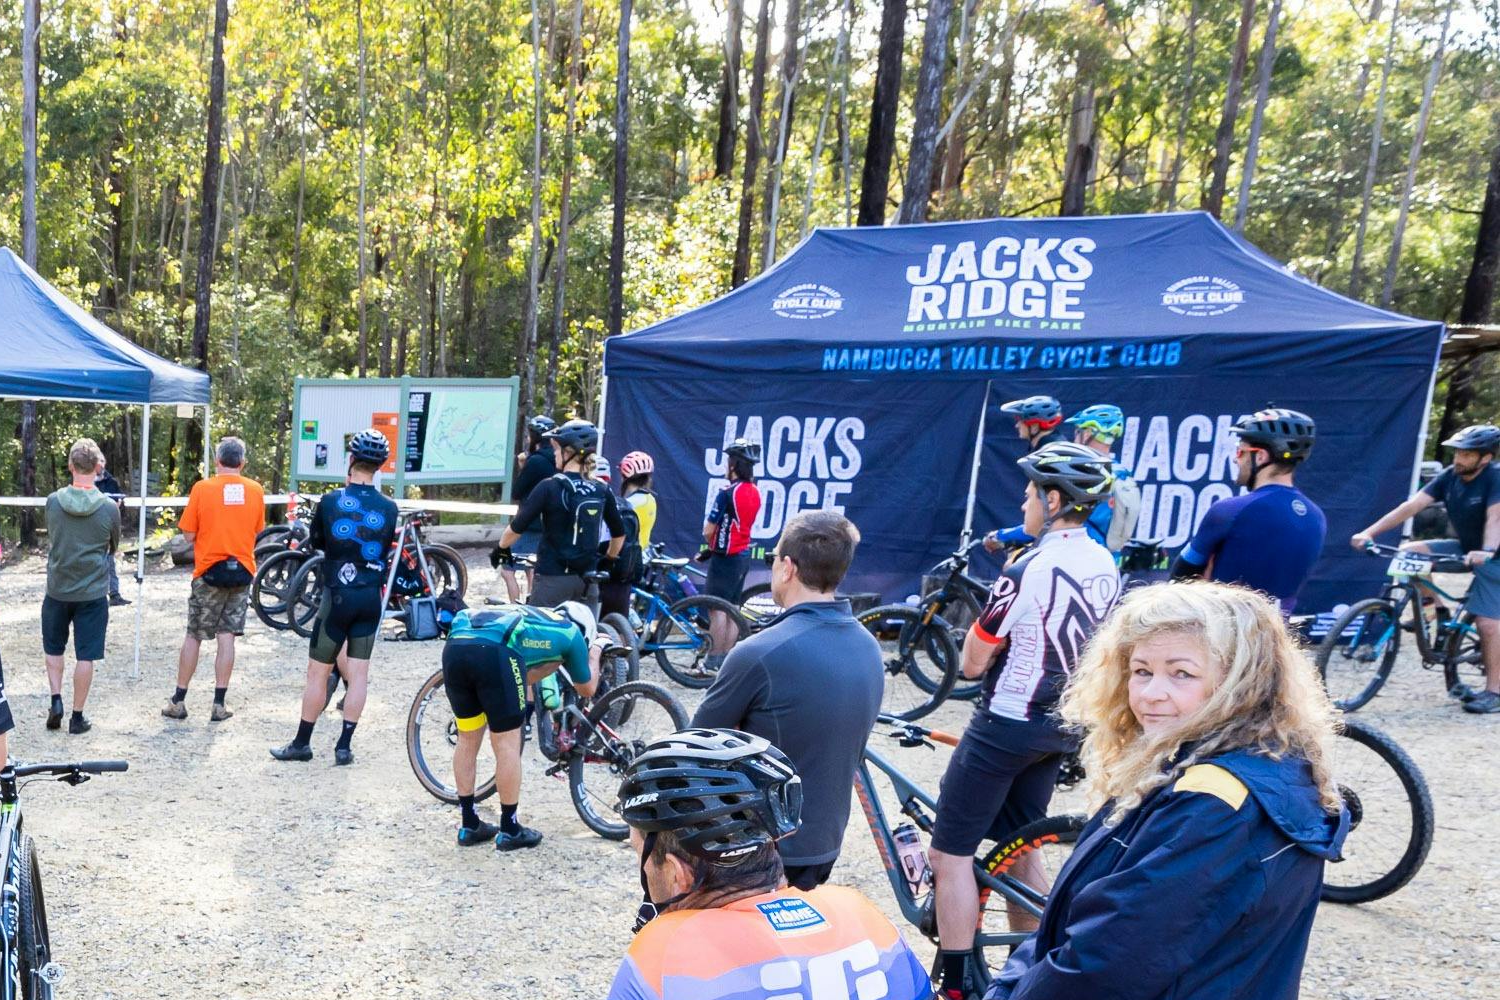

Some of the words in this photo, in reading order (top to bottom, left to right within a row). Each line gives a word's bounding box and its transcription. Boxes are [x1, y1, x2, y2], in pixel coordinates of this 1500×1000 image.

[906, 236, 1097, 285] JACKS
[906, 279, 1087, 323] RIDGE
[903, 319, 986, 332] MOUNTAIN
[994, 318, 1030, 329] BIKE
[1040, 321, 1083, 332] PARK
[822, 347, 943, 371] NAMBUCCA
[952, 345, 1032, 371] VALLEY
[1040, 344, 1114, 369] CYCLE
[1118, 341, 1184, 367] CLUB
[704, 415, 866, 480] JACKS
[1110, 414, 1252, 482] JACK
[702, 478, 853, 539] DGE
[509, 657, 523, 684] JACKS
[624, 792, 660, 809] LAZER
